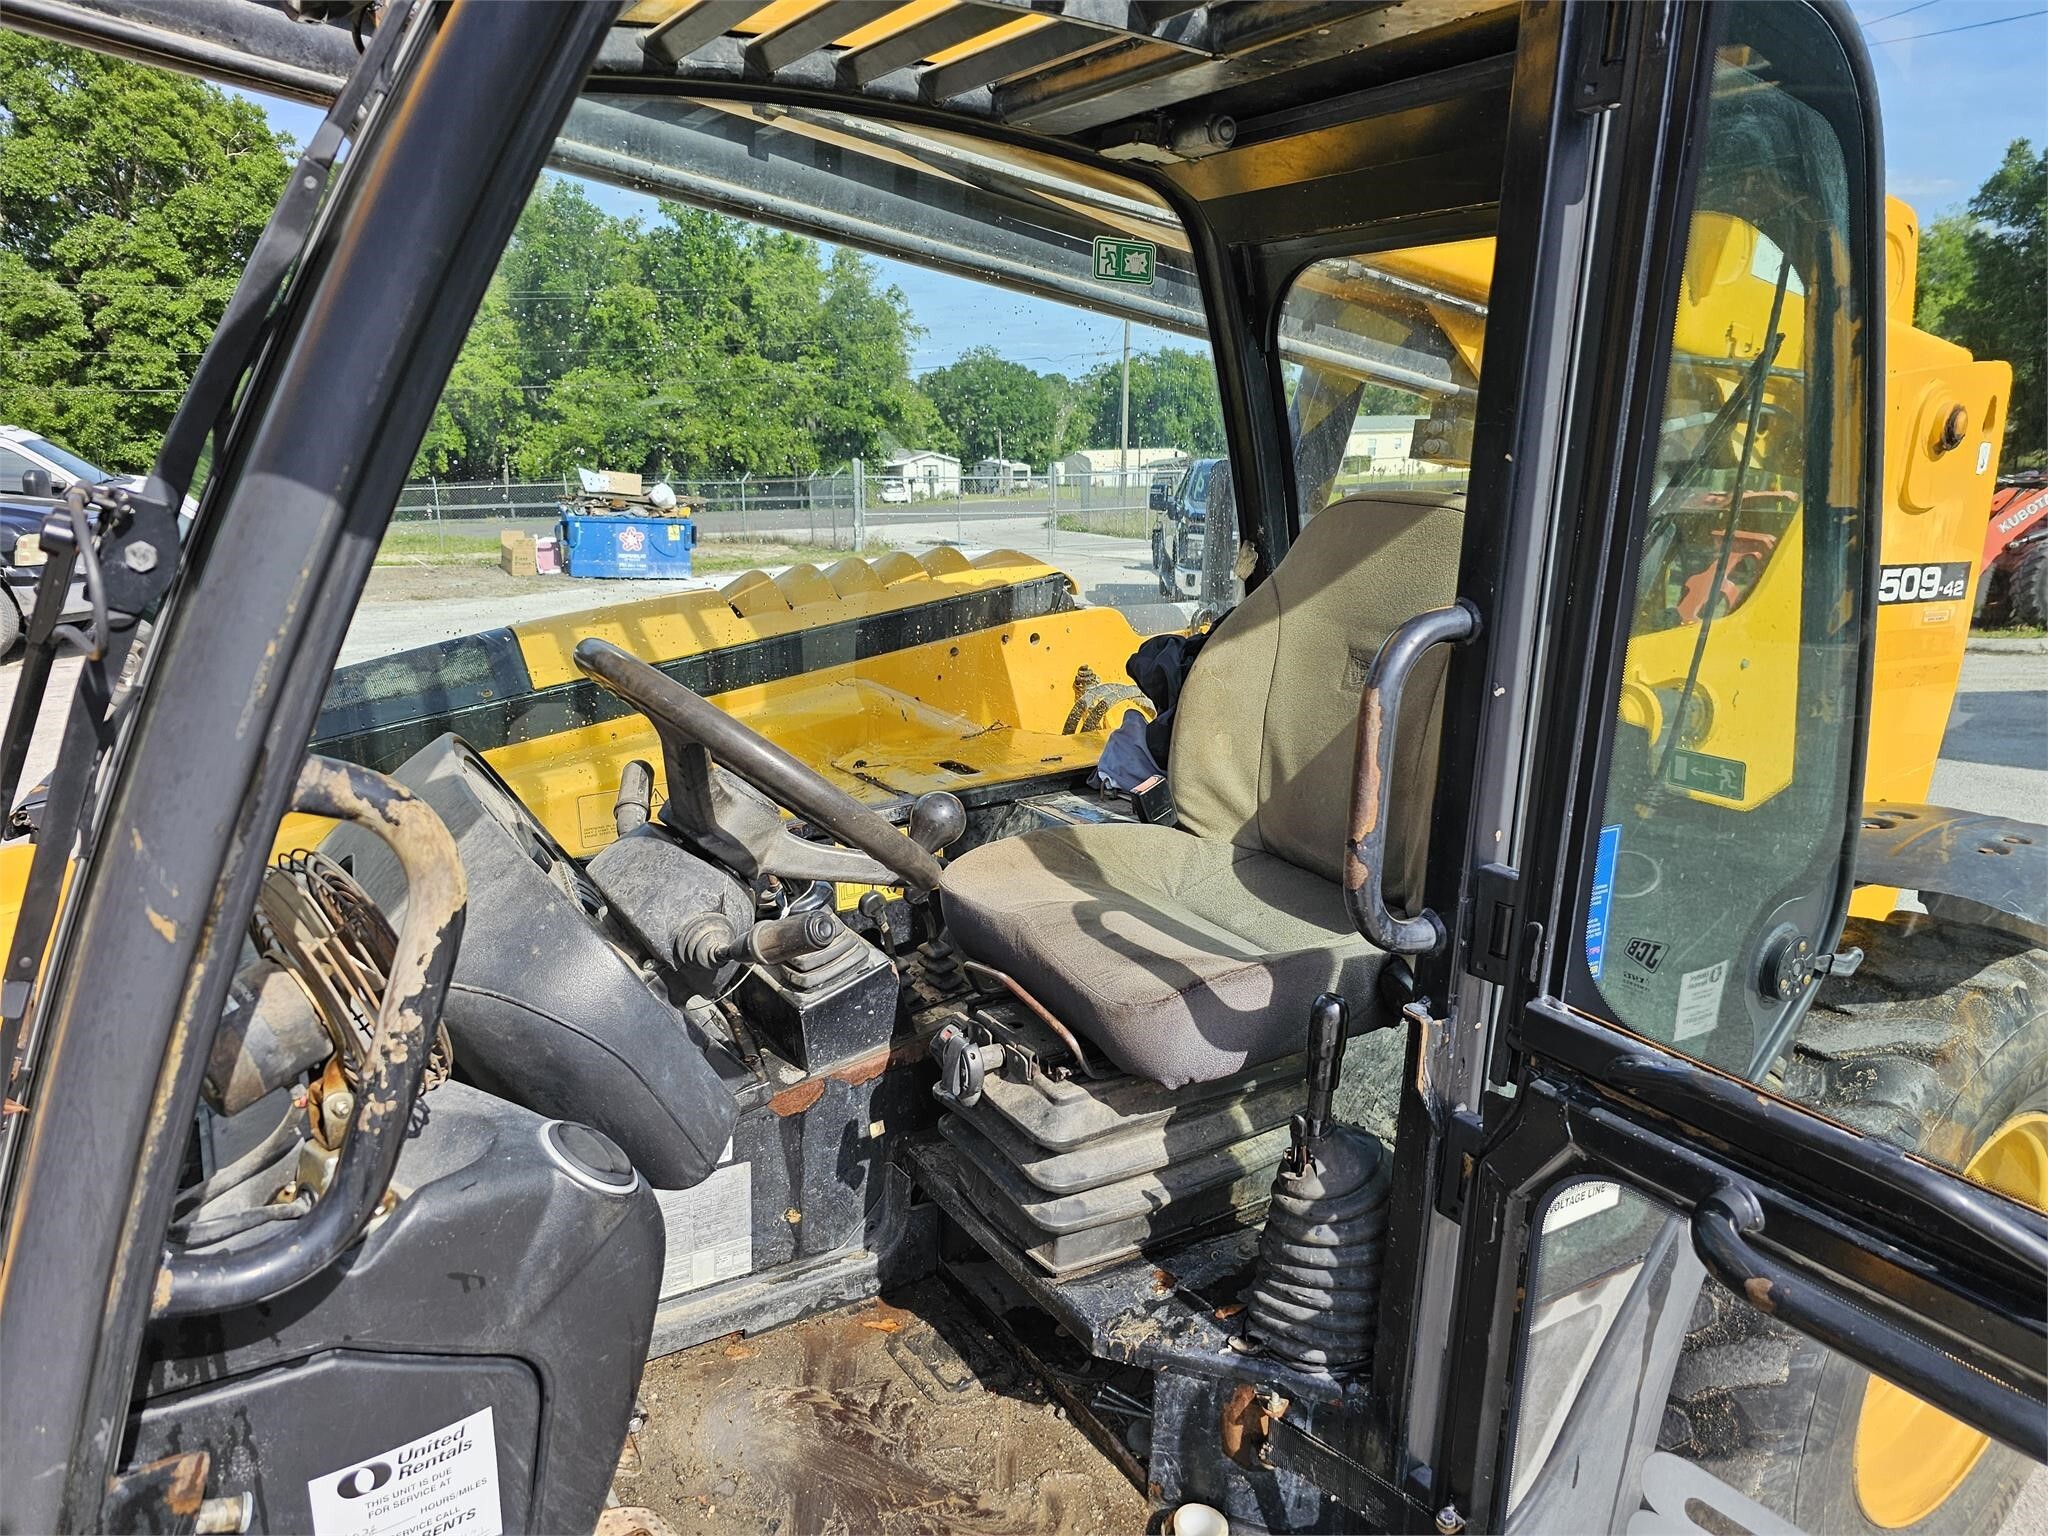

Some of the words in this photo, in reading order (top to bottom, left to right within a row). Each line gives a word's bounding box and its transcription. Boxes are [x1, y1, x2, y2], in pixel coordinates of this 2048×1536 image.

[1588, 1183, 1606, 1198] LINE
[398, 1425, 466, 1464] United
[398, 1437, 473, 1481] Rentals
[366, 1495, 389, 1509] THIS
[392, 1485, 417, 1500] UNIT
[419, 1479, 429, 1489] IS
[432, 1467, 453, 1482] DUE
[368, 1505, 391, 1520] FOR
[393, 1485, 438, 1511] SERVICE
[440, 1478, 452, 1489] AT
[420, 1477, 488, 1514] HOURS/MILES
[435, 1506, 461, 1521] CALL
